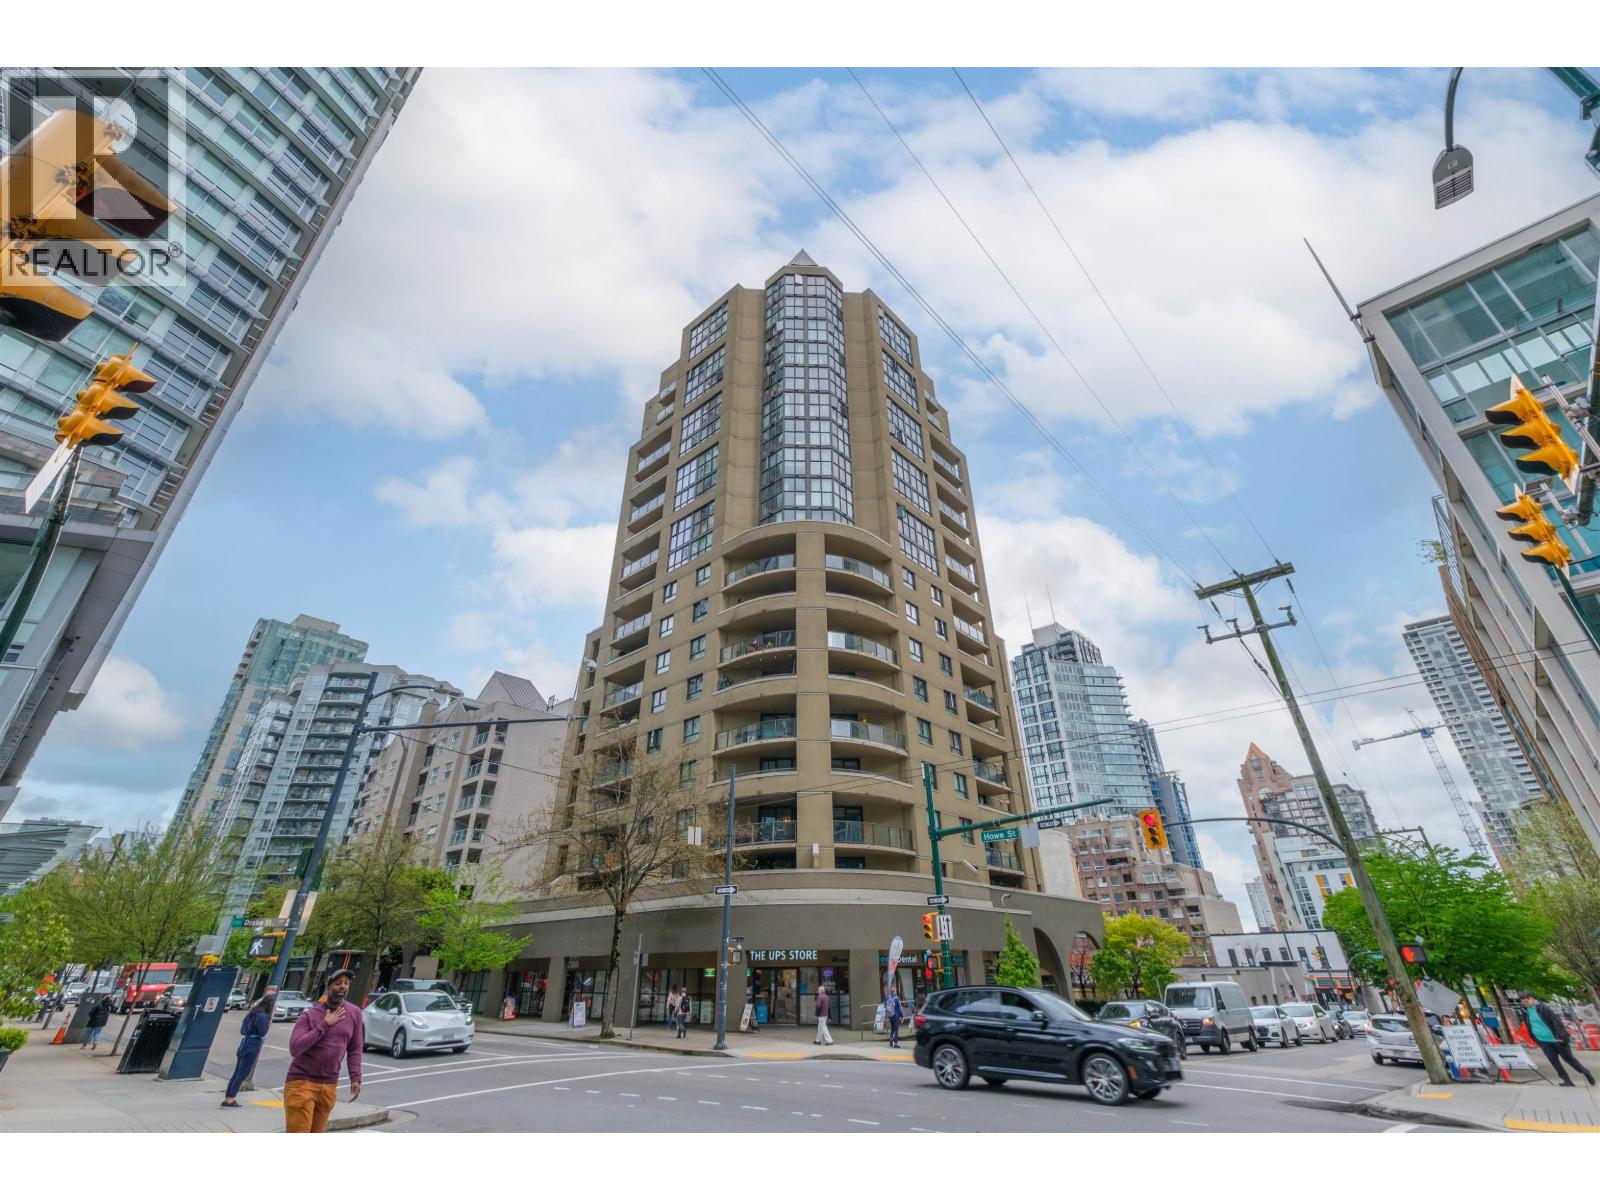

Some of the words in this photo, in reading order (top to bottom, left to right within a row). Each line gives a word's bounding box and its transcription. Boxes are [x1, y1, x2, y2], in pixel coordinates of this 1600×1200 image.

[983, 832, 1004, 841] Howe
[1007, 830, 1016, 838] St
[750, 950, 766, 960] THE
[768, 950, 787, 960] UPS
[789, 950, 818, 960] STORE
